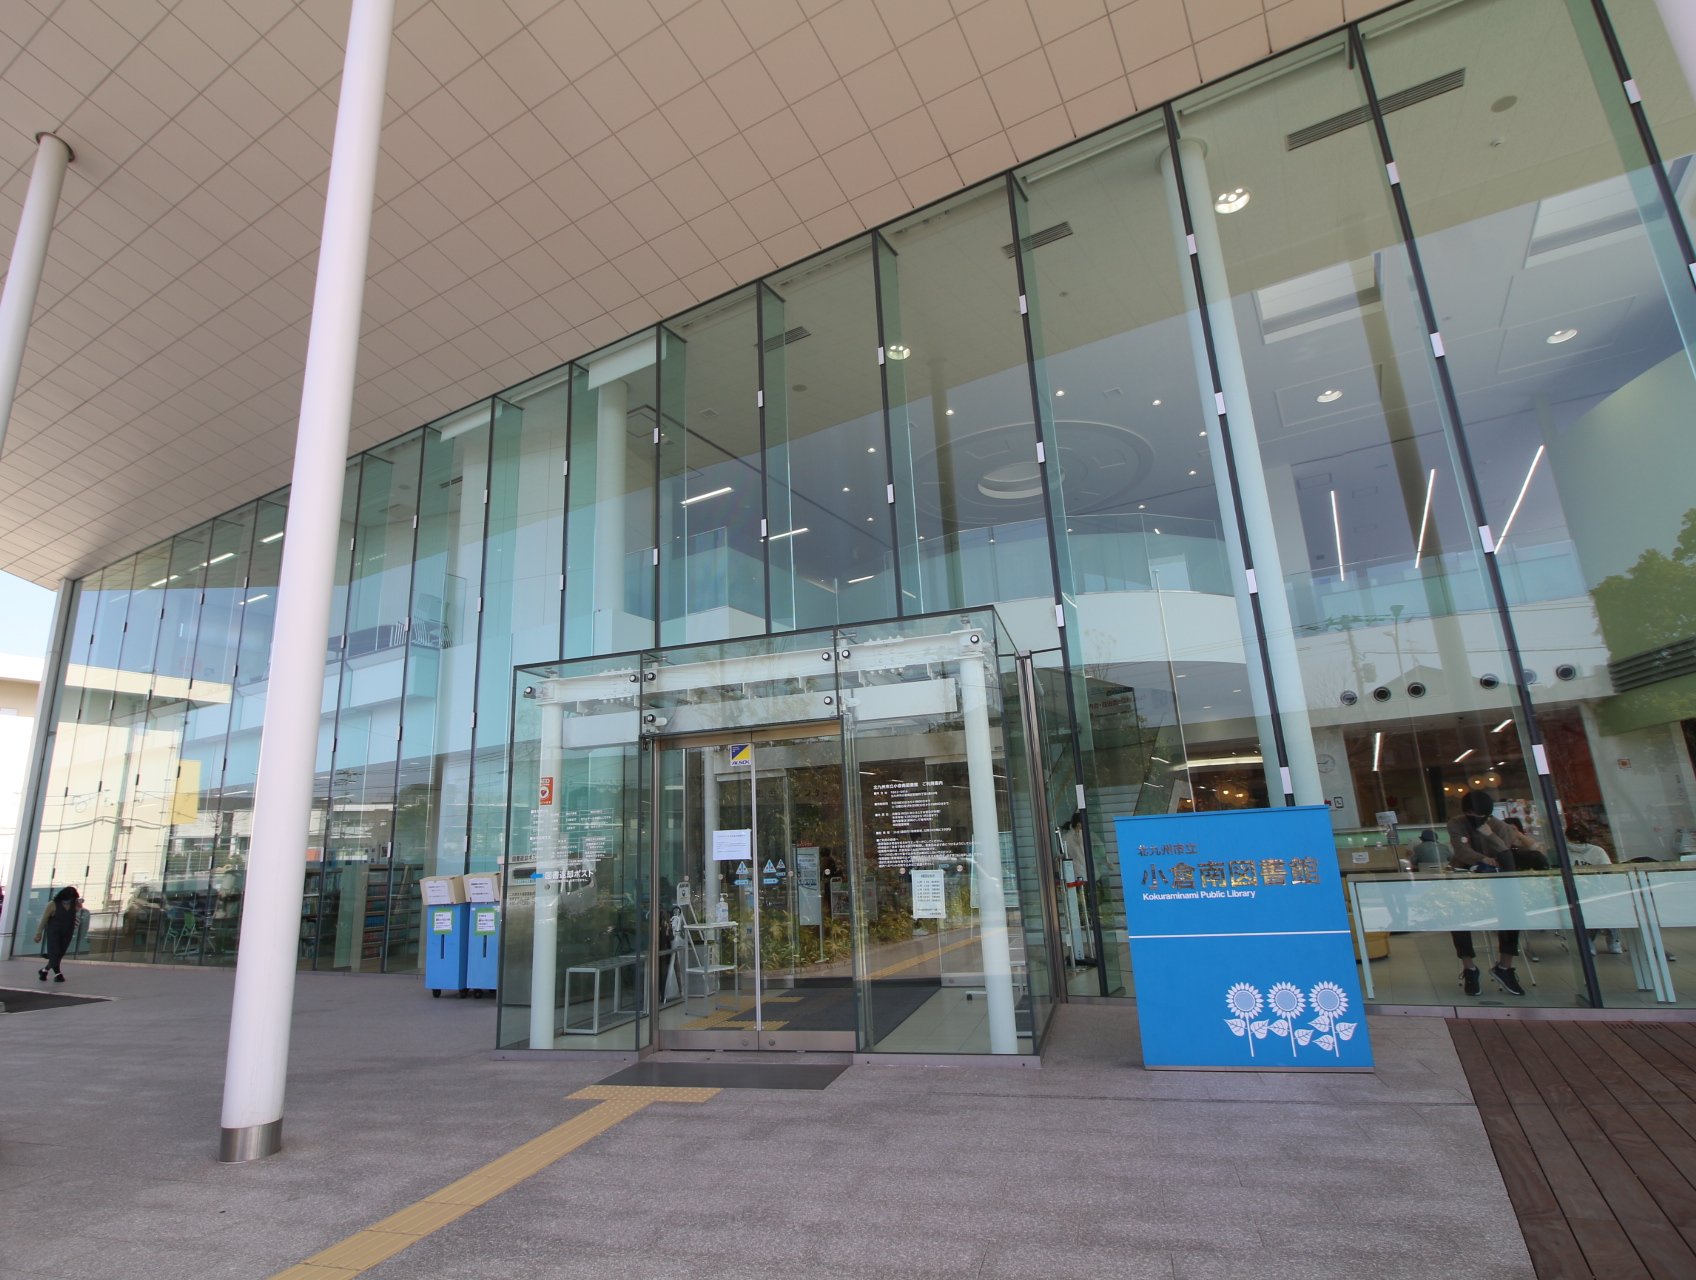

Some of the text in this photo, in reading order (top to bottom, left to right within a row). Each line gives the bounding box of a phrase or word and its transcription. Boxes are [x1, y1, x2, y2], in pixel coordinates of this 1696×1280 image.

[1137, 843, 1199, 857] 北九州市立
[1141, 856, 1321, 890] 小倉南図書館
[1142, 889, 1256, 901] Kokuraminami Public Library
